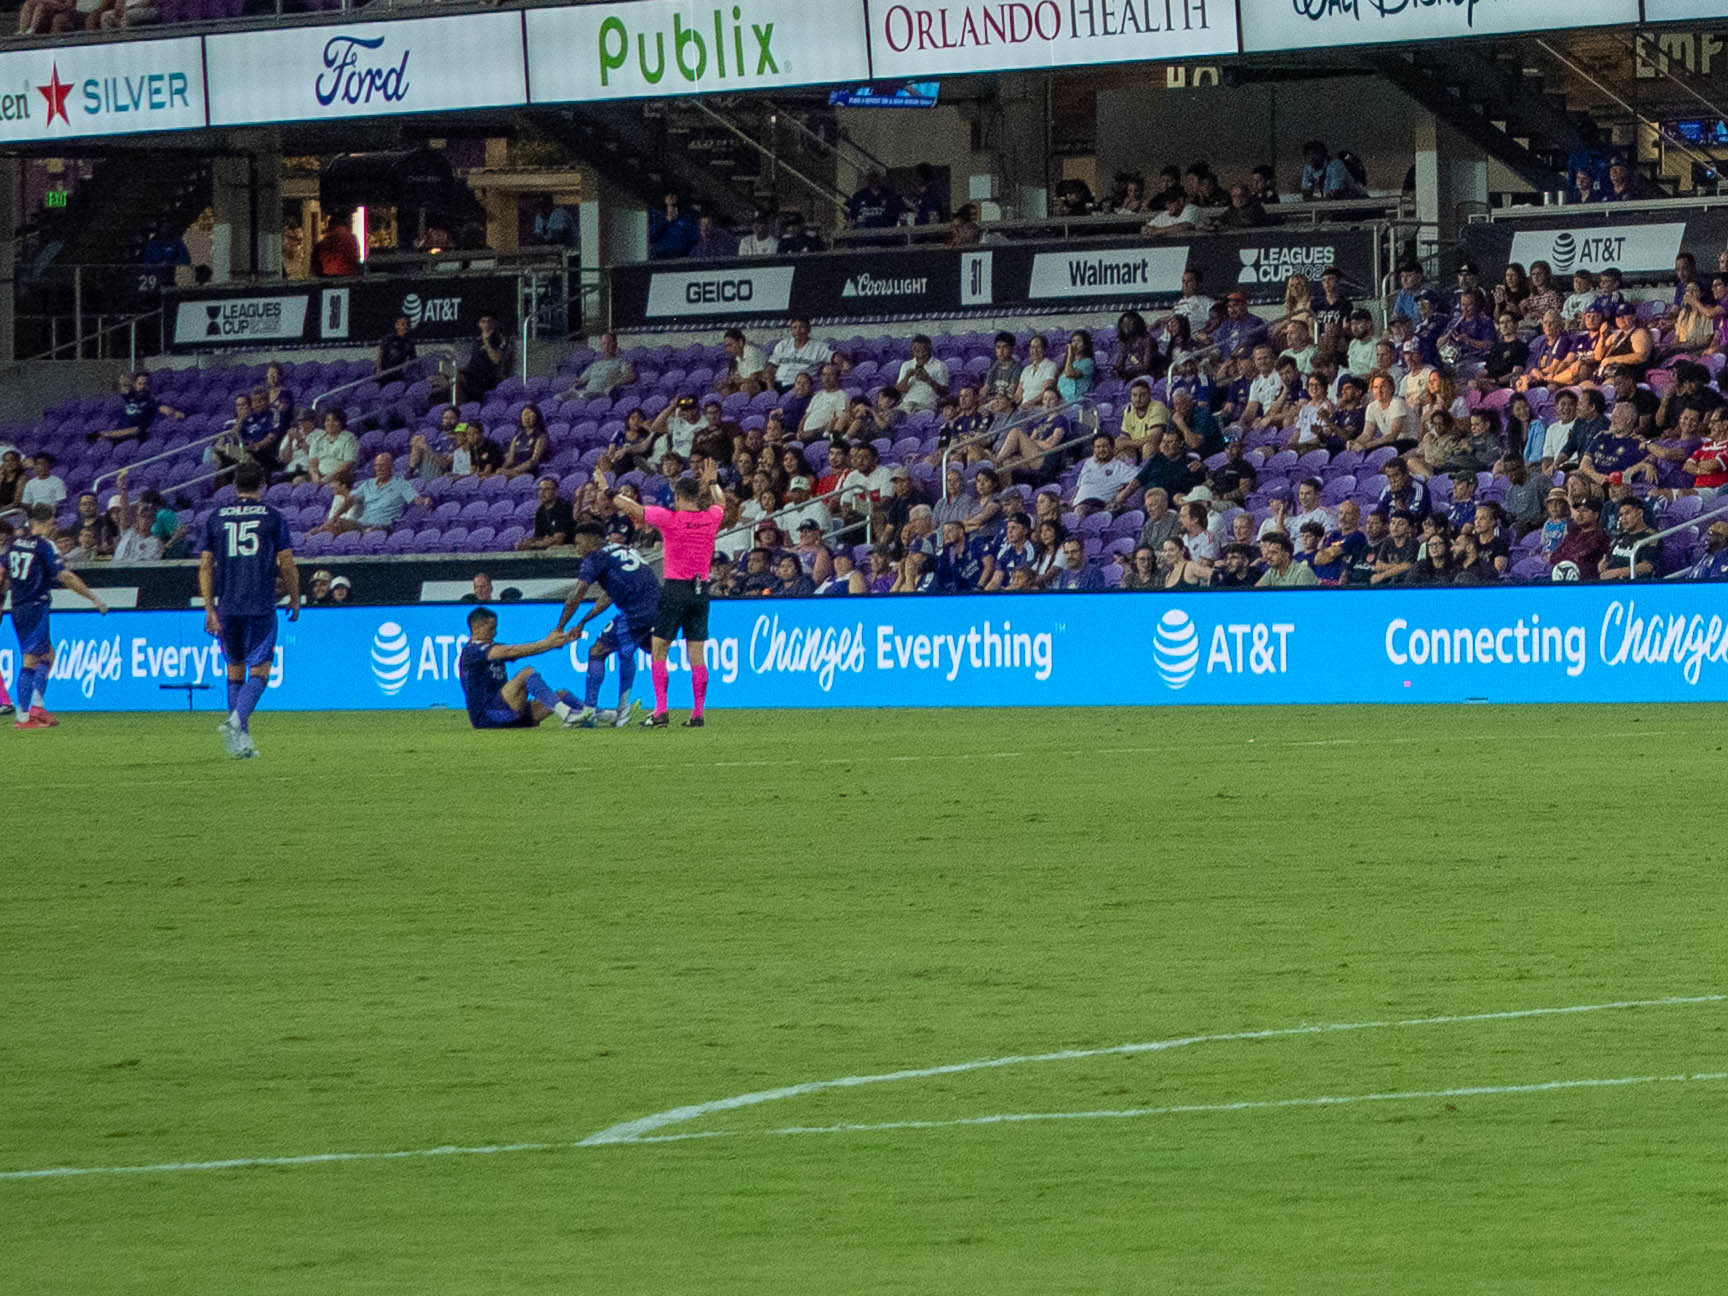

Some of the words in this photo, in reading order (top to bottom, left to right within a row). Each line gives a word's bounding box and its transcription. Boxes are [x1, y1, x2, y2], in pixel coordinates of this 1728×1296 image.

[600, 5, 780, 87] Publix
[314, 34, 411, 106] Ford
[0, 90, 31, 122] en
[82, 72, 190, 118] SILVER
[1259, 246, 1336, 267] LEAGUES
[1580, 236, 1626, 265] AT&T
[138, 273, 158, 291] 29
[856, 271, 895, 298] Coors
[893, 275, 928, 296] LIGHT
[970, 258, 984, 298] 31
[1068, 254, 1149, 289] Walmart
[1259, 264, 1293, 285] CUP
[686, 278, 753, 304] GEICO
[222, 300, 282, 321] LEAGUES
[424, 297, 461, 323] AT&T
[222, 319, 250, 336] CUP
[224, 519, 261, 558] 15
[750, 613, 865, 673] Changes
[874, 621, 1054, 682] Everything
[1207, 621, 1295, 676] AT&T
[1385, 615, 1588, 678] Connecting
